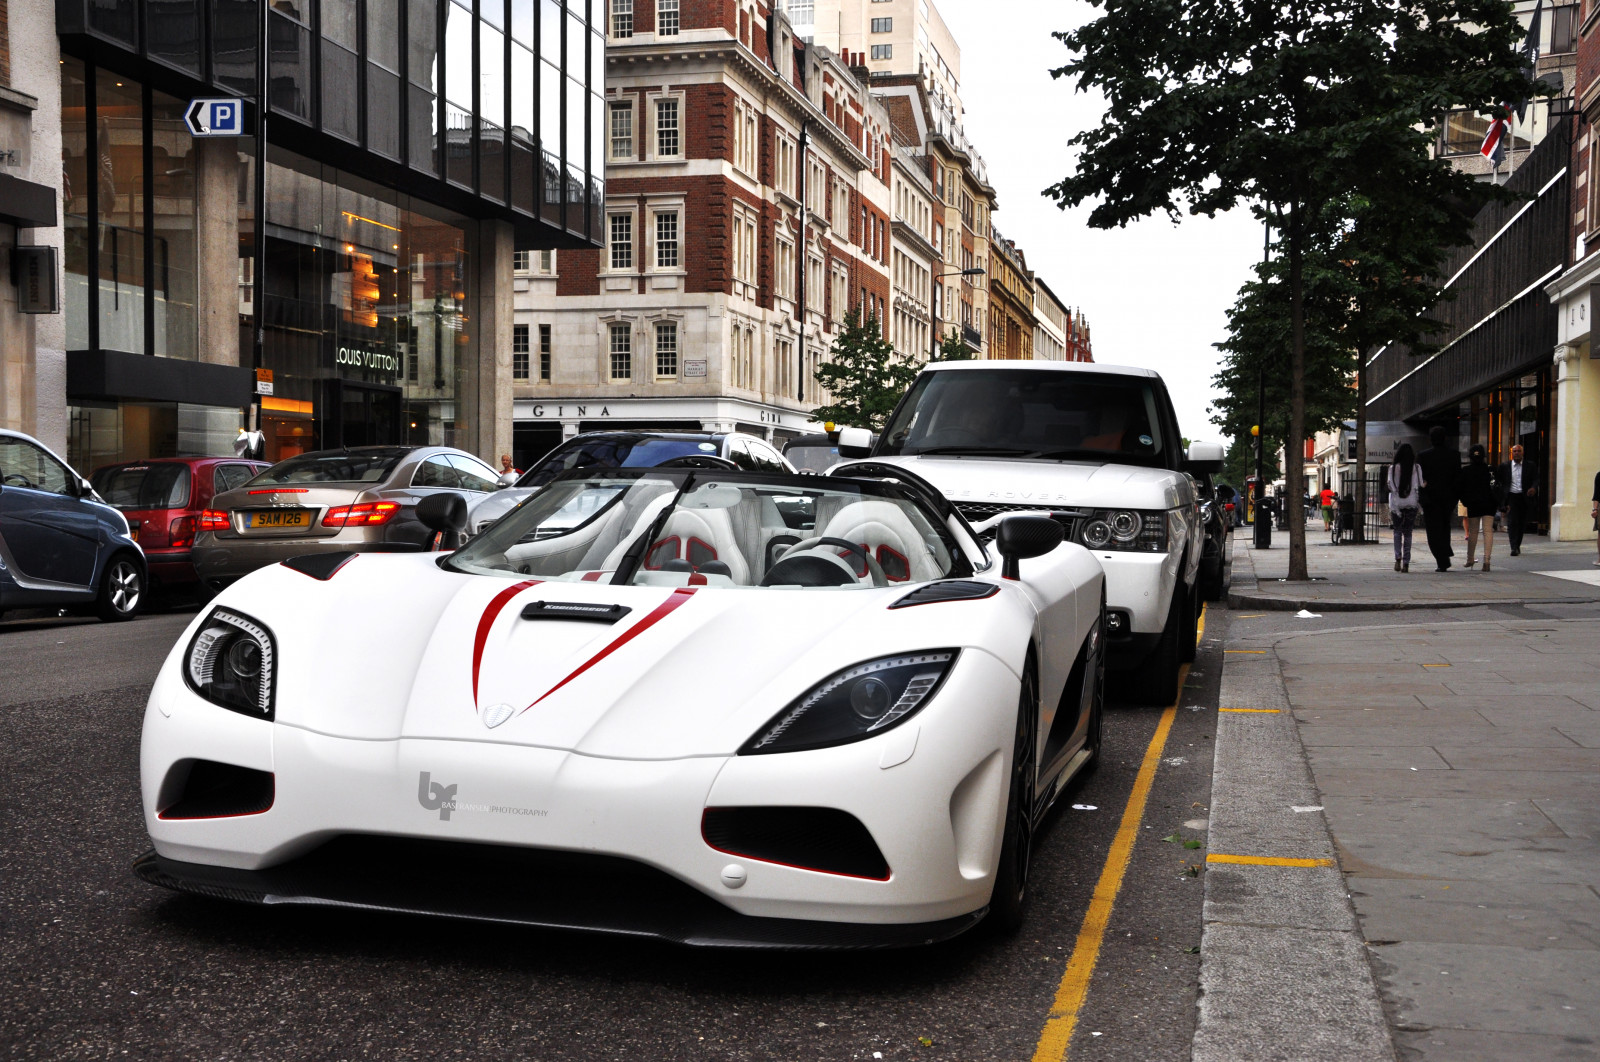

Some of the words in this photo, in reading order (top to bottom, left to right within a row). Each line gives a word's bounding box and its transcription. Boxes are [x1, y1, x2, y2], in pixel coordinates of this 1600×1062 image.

[216, 106, 231, 127] P
[336, 347, 362, 366] LOUIS
[362, 351, 399, 371] VUITTON
[533, 405, 610, 417] GINA
[760, 410, 781, 424] GINA
[987, 491, 1068, 501] ROVER
[258, 514, 281, 525] SAM
[282, 512, 302, 524] 126
